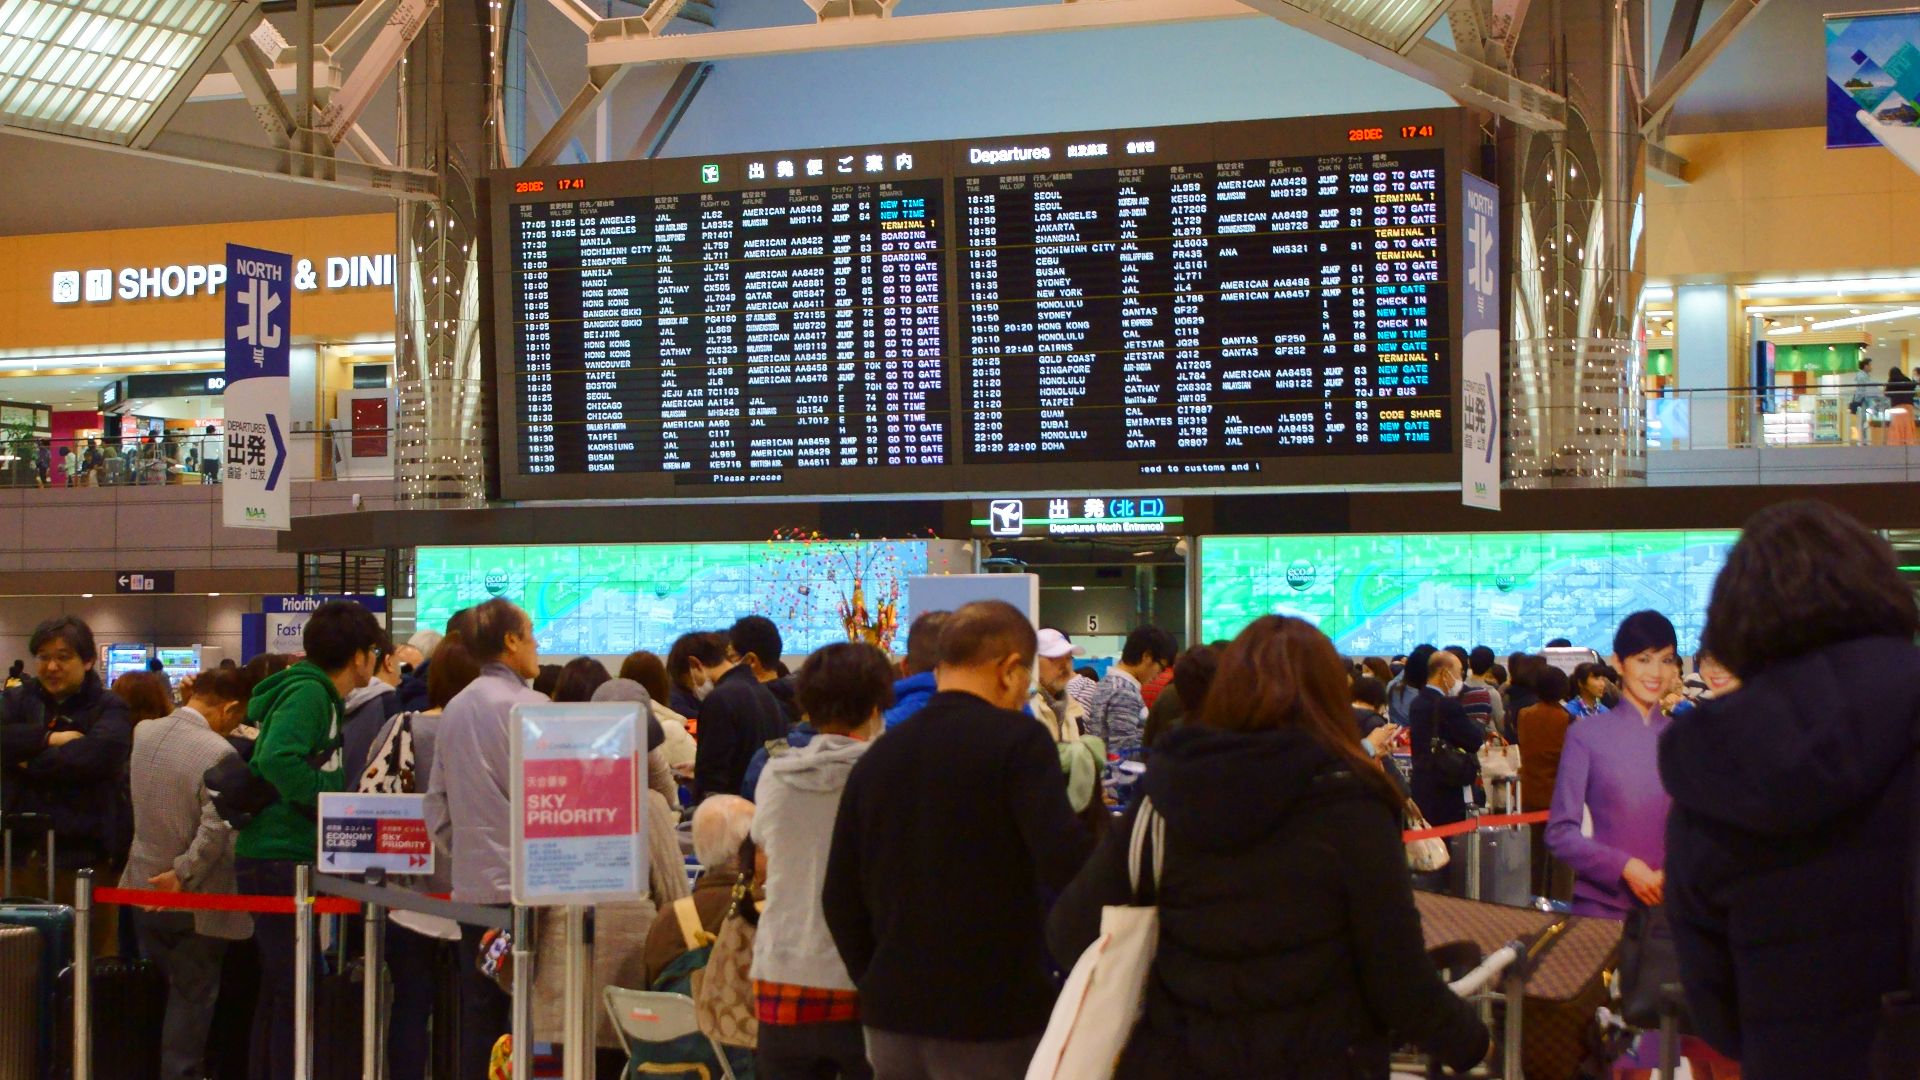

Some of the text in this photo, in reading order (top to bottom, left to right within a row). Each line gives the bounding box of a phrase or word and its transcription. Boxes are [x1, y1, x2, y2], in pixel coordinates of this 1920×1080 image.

[970, 146, 1050, 164] Departures
[1033, 190, 1062, 200] SEOUL
[880, 198, 924, 209] NEW TIME
[1034, 201, 1062, 211] SEOUL
[1468, 190, 1493, 217] NORTH
[579, 215, 636, 226] LOS ANGELES
[1034, 210, 1097, 222] LOS ANGELES
[881, 219, 925, 230] TERMINAL
[1034, 222, 1075, 232] JAKARTA
[580, 225, 636, 236] LOS ANGELES
[880, 230, 926, 241] BOARDING
[580, 237, 611, 246] MANILA
[743, 238, 786, 248] AMERICAN
[1035, 233, 1079, 243] SHANGHAI
[580, 245, 652, 256] HOCHIMINH CITY
[1035, 242, 1115, 255] HOCHIMINH CITY
[1219, 247, 1238, 256] ANA
[881, 252, 926, 262] BOARDING
[1468, 212, 1493, 296] 北
[581, 256, 627, 266] SINGAPORE
[1035, 256, 1059, 266] CEBU
[237, 258, 282, 281] NORTH
[294, 258, 318, 290] &
[326, 254, 396, 288] DINI
[581, 268, 612, 277] MANILA
[1035, 266, 1065, 276] BUSAN
[581, 278, 607, 287] HANOI
[1036, 277, 1071, 287] SYDNEY
[582, 288, 628, 298] HONG KONG
[657, 285, 689, 294] CATHAY
[1036, 287, 1082, 298] NEW YORK
[745, 291, 772, 300] QATAR
[1376, 295, 1427, 306] CHECK IN
[582, 298, 629, 308] HONG KONG
[1036, 299, 1083, 309] HONOLULU
[237, 278, 281, 348] 北
[1037, 310, 1071, 320] SYDNEY
[1121, 307, 1157, 316] QANTAS
[1037, 320, 1090, 331] HONG KONG
[583, 329, 620, 338] BEIJING
[1037, 331, 1084, 341] HONOLULU
[584, 339, 630, 349] HONG KONG
[1038, 342, 1073, 352] CAIRNS
[1123, 339, 1164, 349] JETSTAR
[584, 349, 630, 359] HONG KONG
[1221, 347, 1258, 357] QANTAS
[1038, 353, 1096, 364] GOLD COAST
[584, 359, 631, 369] VANCOUVER
[1039, 364, 1090, 375] SINGAPORE
[585, 371, 615, 380] TAIPEI
[1039, 375, 1085, 386] HONOLULU
[208, 378, 225, 389] BO
[585, 381, 616, 390] BOSTON
[586, 391, 611, 400] SEOUL
[1039, 386, 1085, 396] HONOLULU
[1378, 386, 1416, 397] BY BUS
[586, 401, 622, 410] CHICAGO
[661, 399, 703, 408] AMERICAN
[1040, 397, 1073, 407] TAIPEI
[586, 411, 622, 420] CHICAGO
[886, 413, 925, 422] ON TIME
[1040, 409, 1064, 418] GUAM
[1379, 409, 1441, 419] CODE SHARE
[1040, 419, 1068, 429] DUBAI
[1125, 416, 1172, 427] EMIRATES
[1379, 420, 1429, 431] NEW GATE
[228, 420, 266, 434] DEPARTURES
[587, 432, 617, 441] TAIPEI
[1040, 430, 1087, 440] HONOLULU
[228, 433, 266, 466] 出発
[587, 442, 634, 451] KAOHSIUNG
[1041, 441, 1064, 450] DOHA
[587, 453, 614, 461] BUSAN
[588, 463, 614, 471] BUSAN
[1184, 464, 1225, 472] customs
[1231, 463, 1249, 471] and
[246, 507, 266, 518] NAA
[1050, 522, 1164, 534] Departures (North Entrance)
[283, 597, 321, 611] Priority
[1090, 616, 1096, 630] 5
[277, 624, 302, 636] Fast
[528, 794, 566, 809] SKY
[528, 808, 618, 825] PRIORITY
[326, 832, 372, 840] ECONOMY
